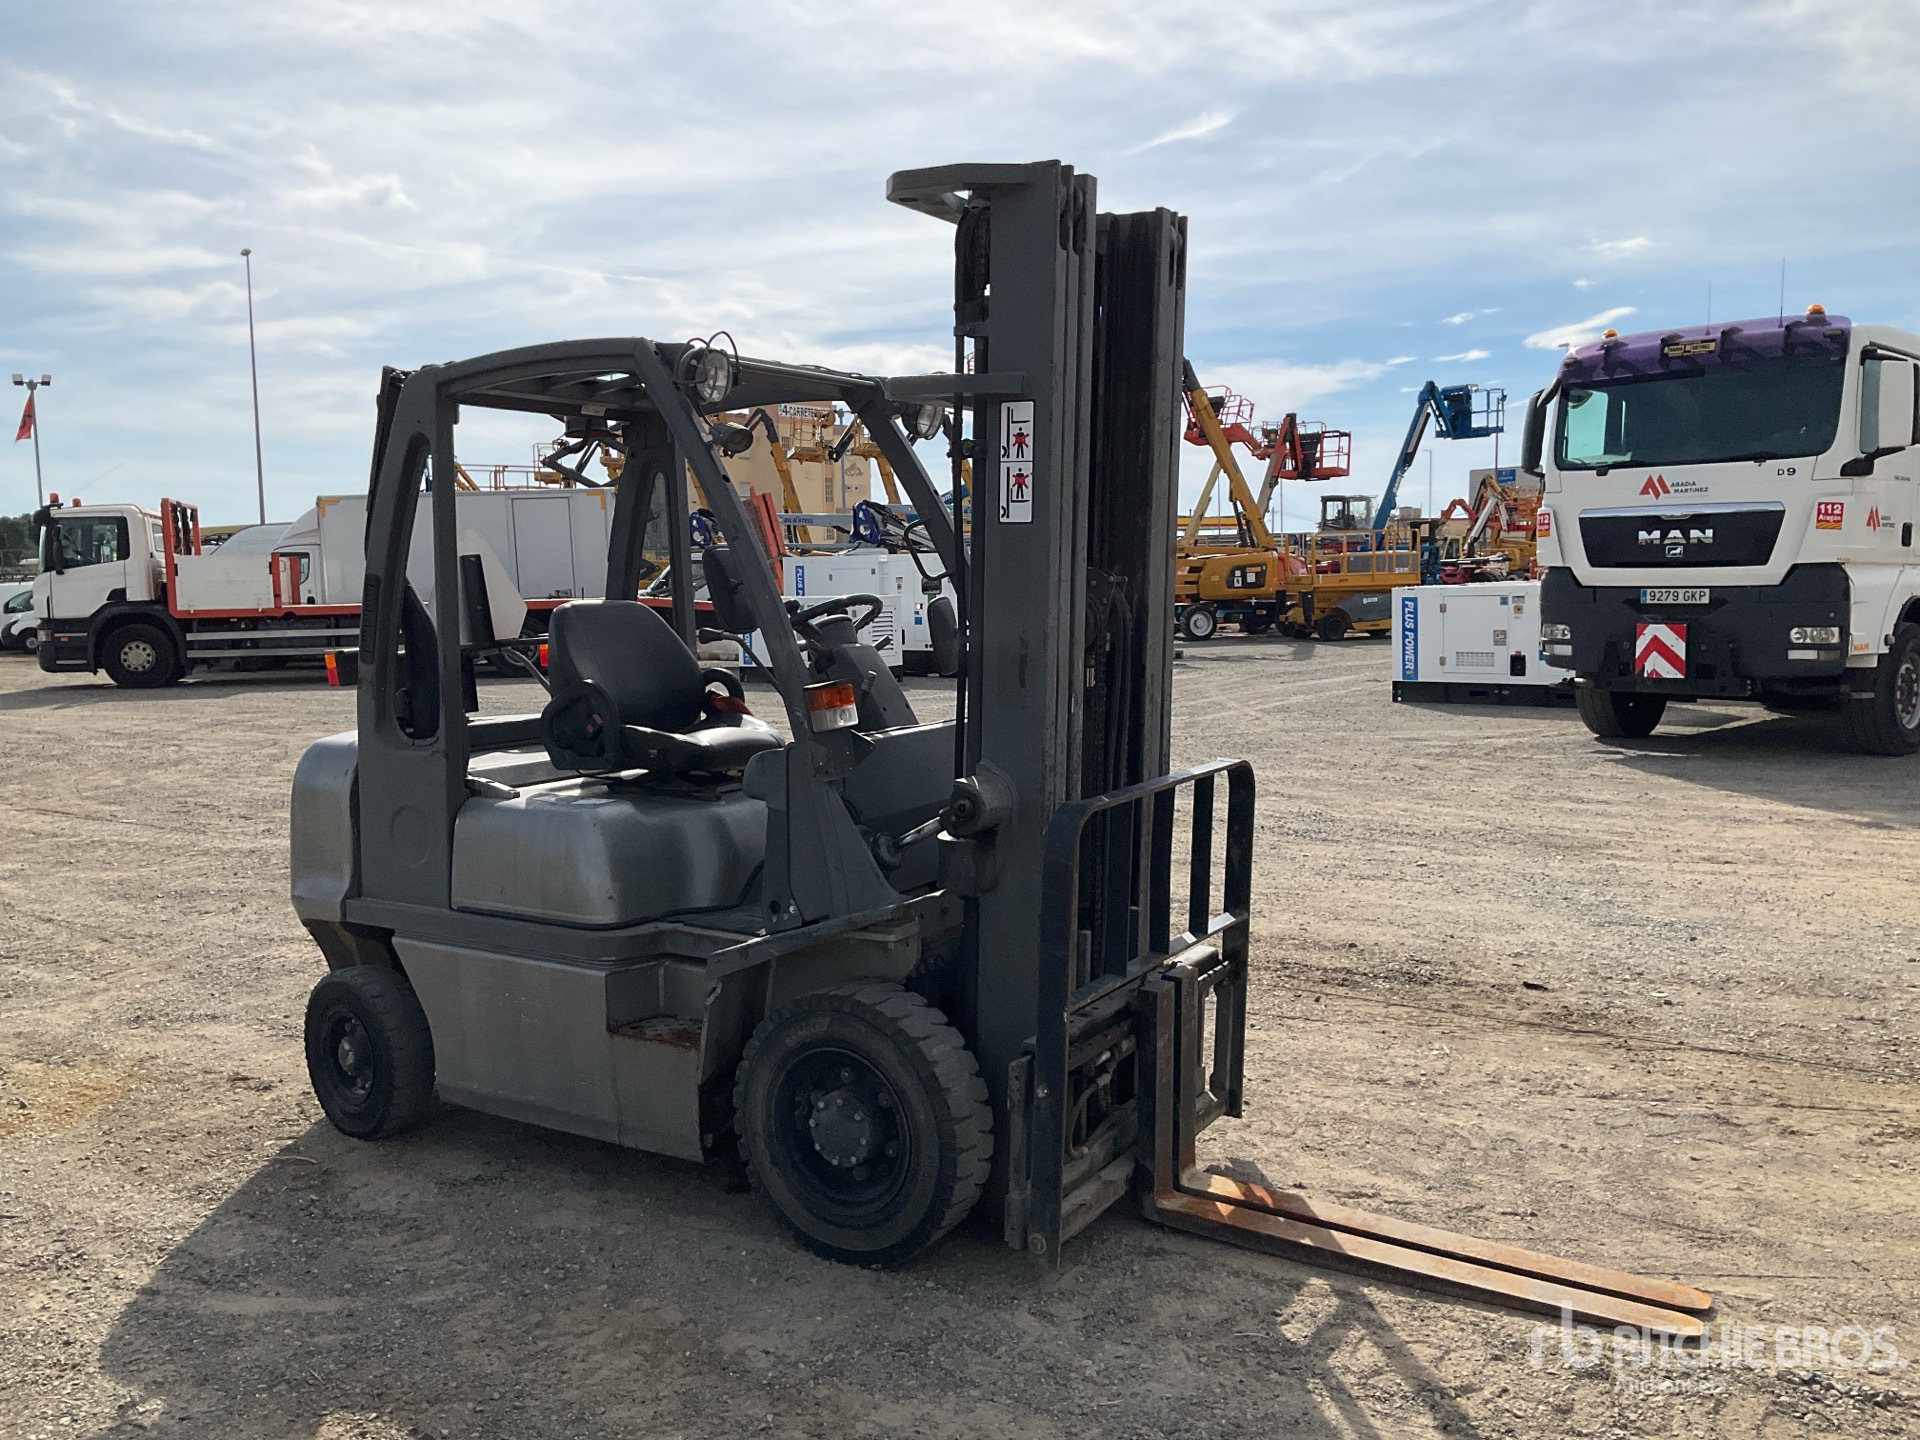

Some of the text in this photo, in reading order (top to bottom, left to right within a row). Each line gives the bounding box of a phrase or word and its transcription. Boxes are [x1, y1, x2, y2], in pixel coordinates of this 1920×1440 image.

[1819, 503, 1842, 514] 112
[1638, 529, 1713, 545] MAN
[1362, 596, 1378, 605] gam
[1649, 590, 1706, 602] 9279 GKP
[1404, 600, 1415, 670] PLUS POWER
